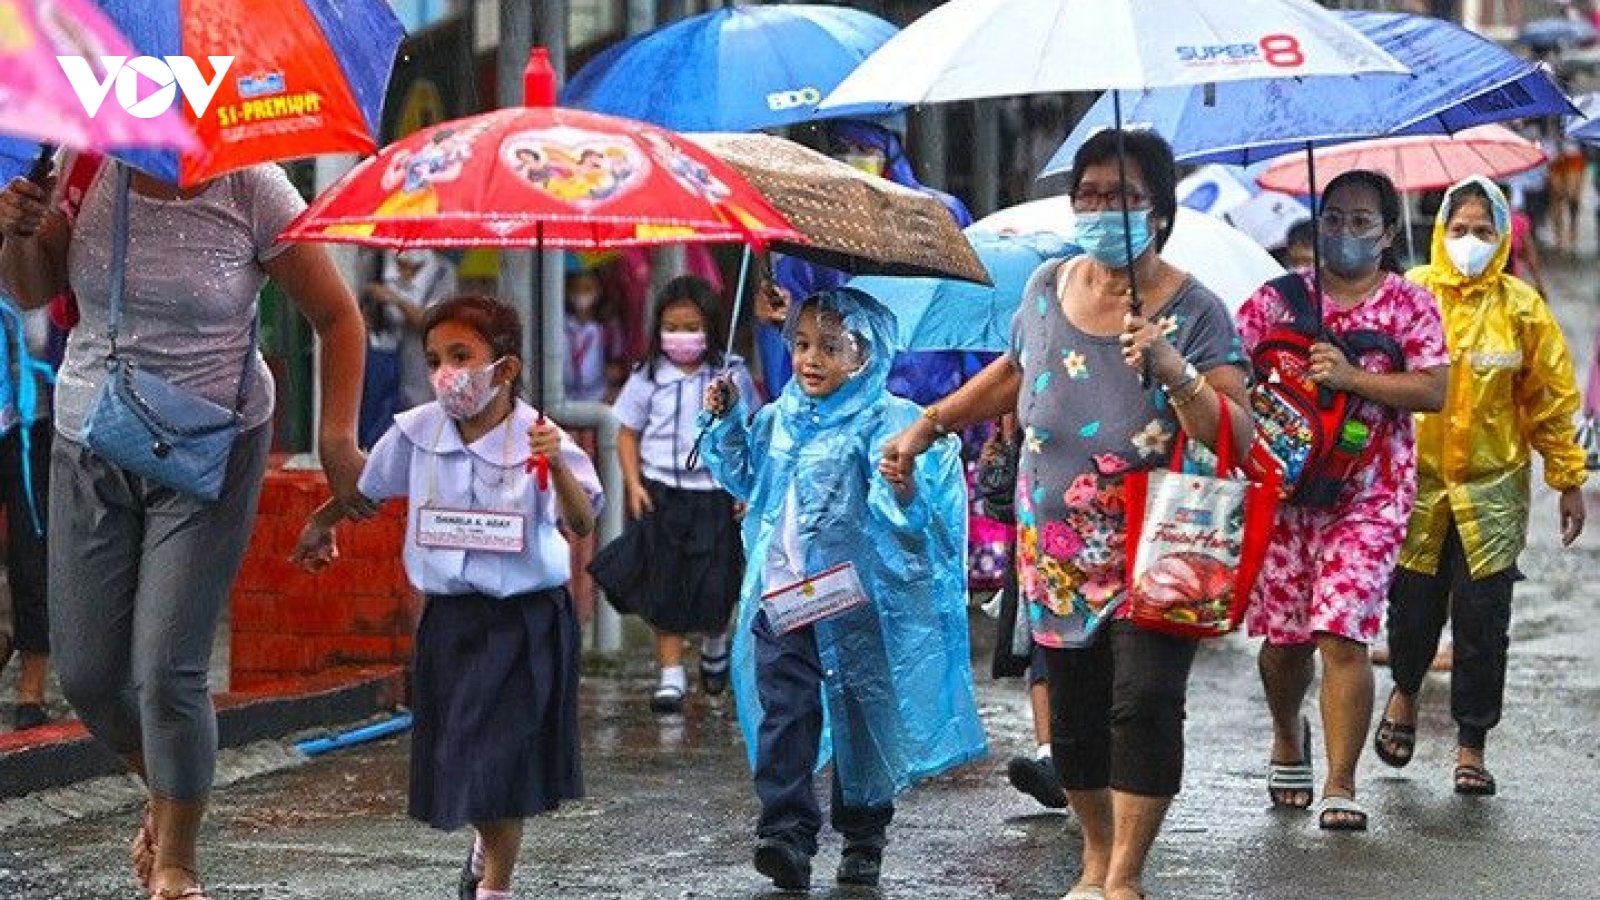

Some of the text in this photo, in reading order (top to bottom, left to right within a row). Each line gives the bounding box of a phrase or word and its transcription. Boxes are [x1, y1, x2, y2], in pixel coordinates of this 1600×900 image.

[1174, 34, 1305, 67] SUPER 8
[767, 87, 820, 110] BDO
